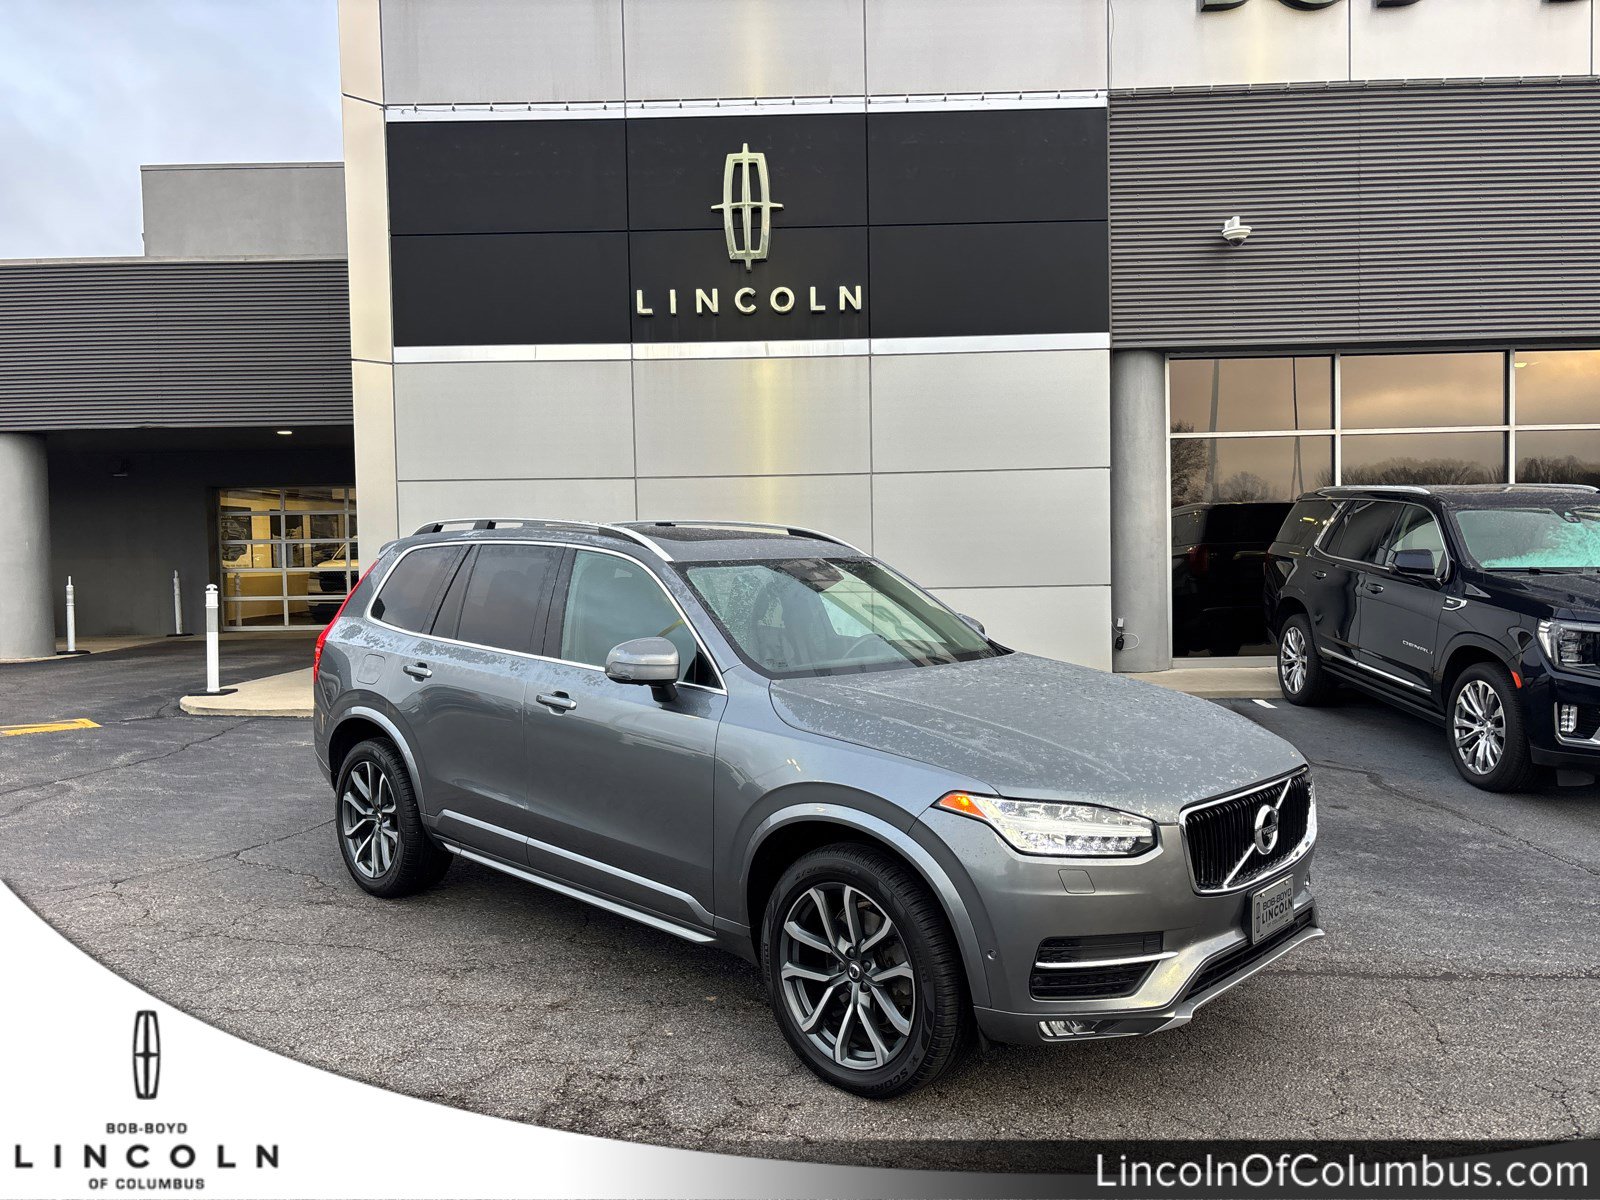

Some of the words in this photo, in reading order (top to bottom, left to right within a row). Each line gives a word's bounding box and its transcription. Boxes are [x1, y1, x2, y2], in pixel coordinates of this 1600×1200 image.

[636, 286, 862, 315] LINCOLN
[1402, 640, 1433, 655] DENALI
[1261, 896, 1293, 925] LINCOLN
[1262, 888, 1292, 911] BOB-BOYD
